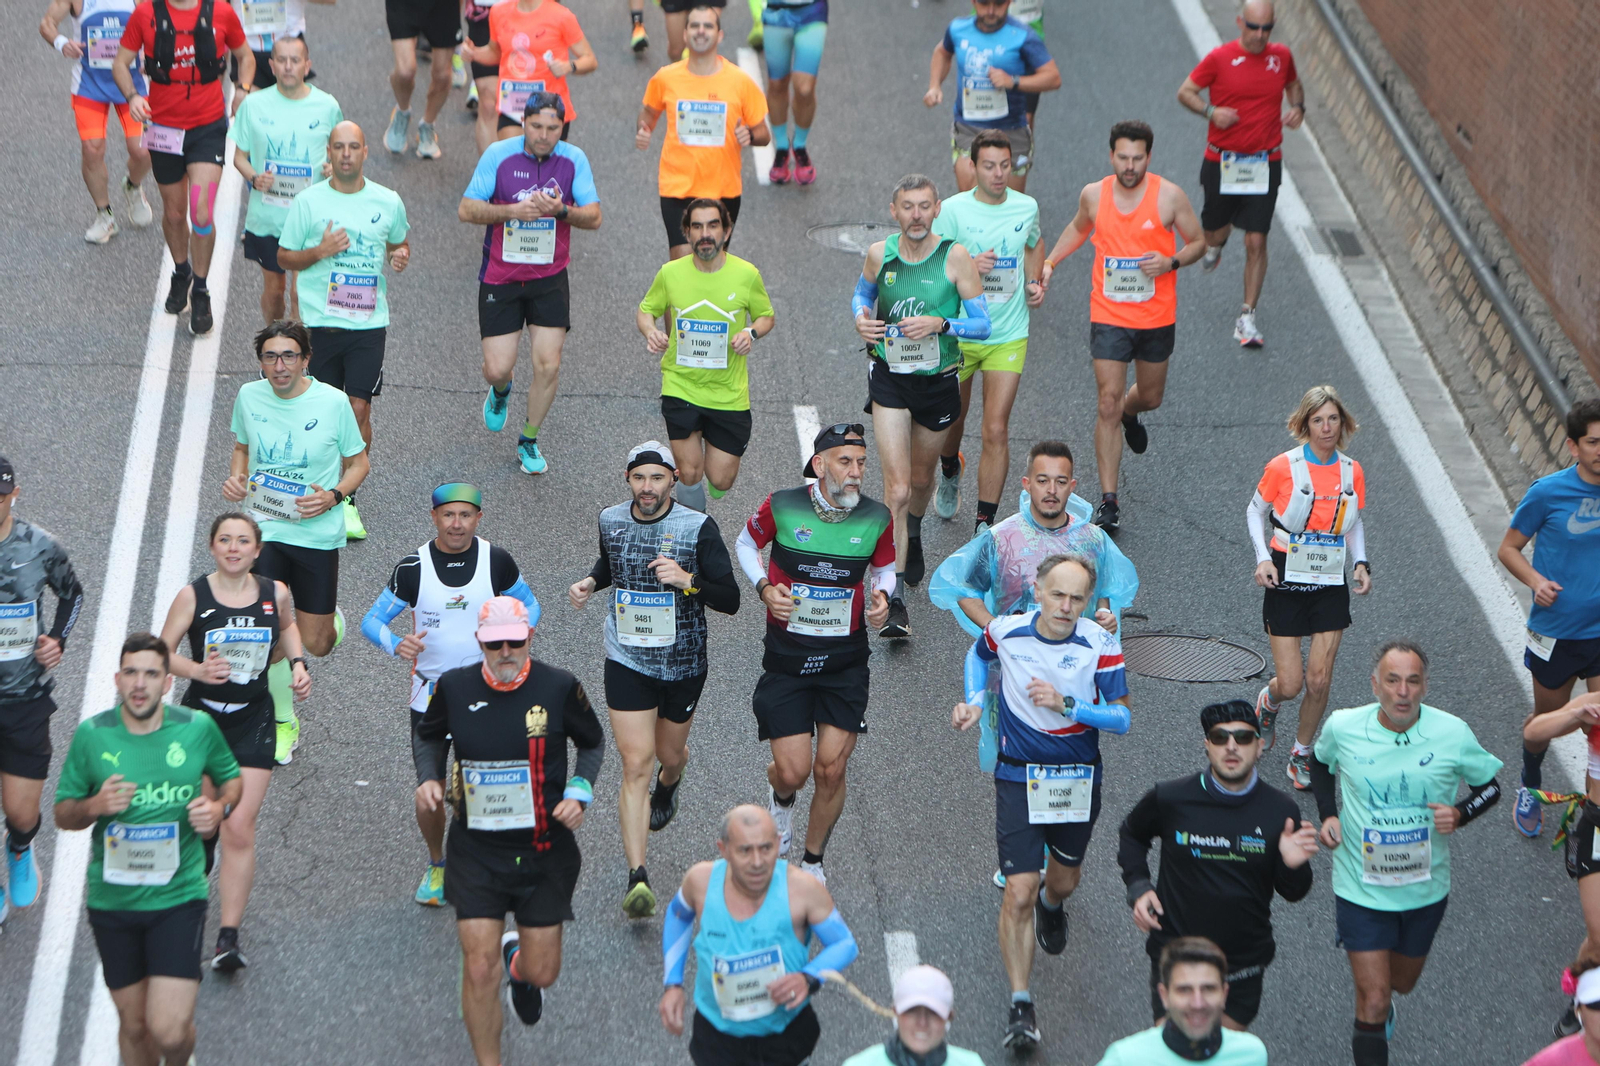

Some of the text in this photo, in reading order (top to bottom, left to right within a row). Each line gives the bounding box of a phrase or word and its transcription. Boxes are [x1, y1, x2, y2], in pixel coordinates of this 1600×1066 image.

[280, 166, 307, 176] ZURICH
[279, 181, 295, 190] 9070
[520, 236, 540, 244] 10207
[348, 277, 374, 286] ZURICH
[1114, 284, 1136, 292] CARLOS
[346, 292, 362, 300] 7805
[330, 298, 356, 309] GONÇALO
[693, 324, 721, 332] ZURICH
[900, 344, 921, 352] 10057
[900, 354, 924, 362] PATRICE
[266, 479, 300, 494] ZURICH
[263, 495, 284, 508] 10966
[252, 503, 291, 520] SALVATIERRA
[1306, 552, 1327, 562] 10768
[813, 589, 846, 598] ZURICH
[634, 596, 666, 604] ZURICH
[811, 607, 830, 616] 8924
[634, 614, 652, 623] 9481
[798, 616, 842, 626] MANULOSETA
[635, 626, 653, 634] MATU
[228, 632, 264, 642] ZURICH
[807, 654, 829, 662] COMP
[484, 772, 520, 783] ZURICH
[1050, 768, 1084, 778] ZURICH
[131, 781, 194, 808] aldro
[1048, 788, 1072, 797] 10268
[128, 826, 169, 839] ZURICH
[1384, 831, 1420, 844] ZURICH
[1189, 834, 1230, 848] MetLife
[1379, 862, 1423, 873] FERNANDEZ
[732, 952, 772, 974] ZURICH
